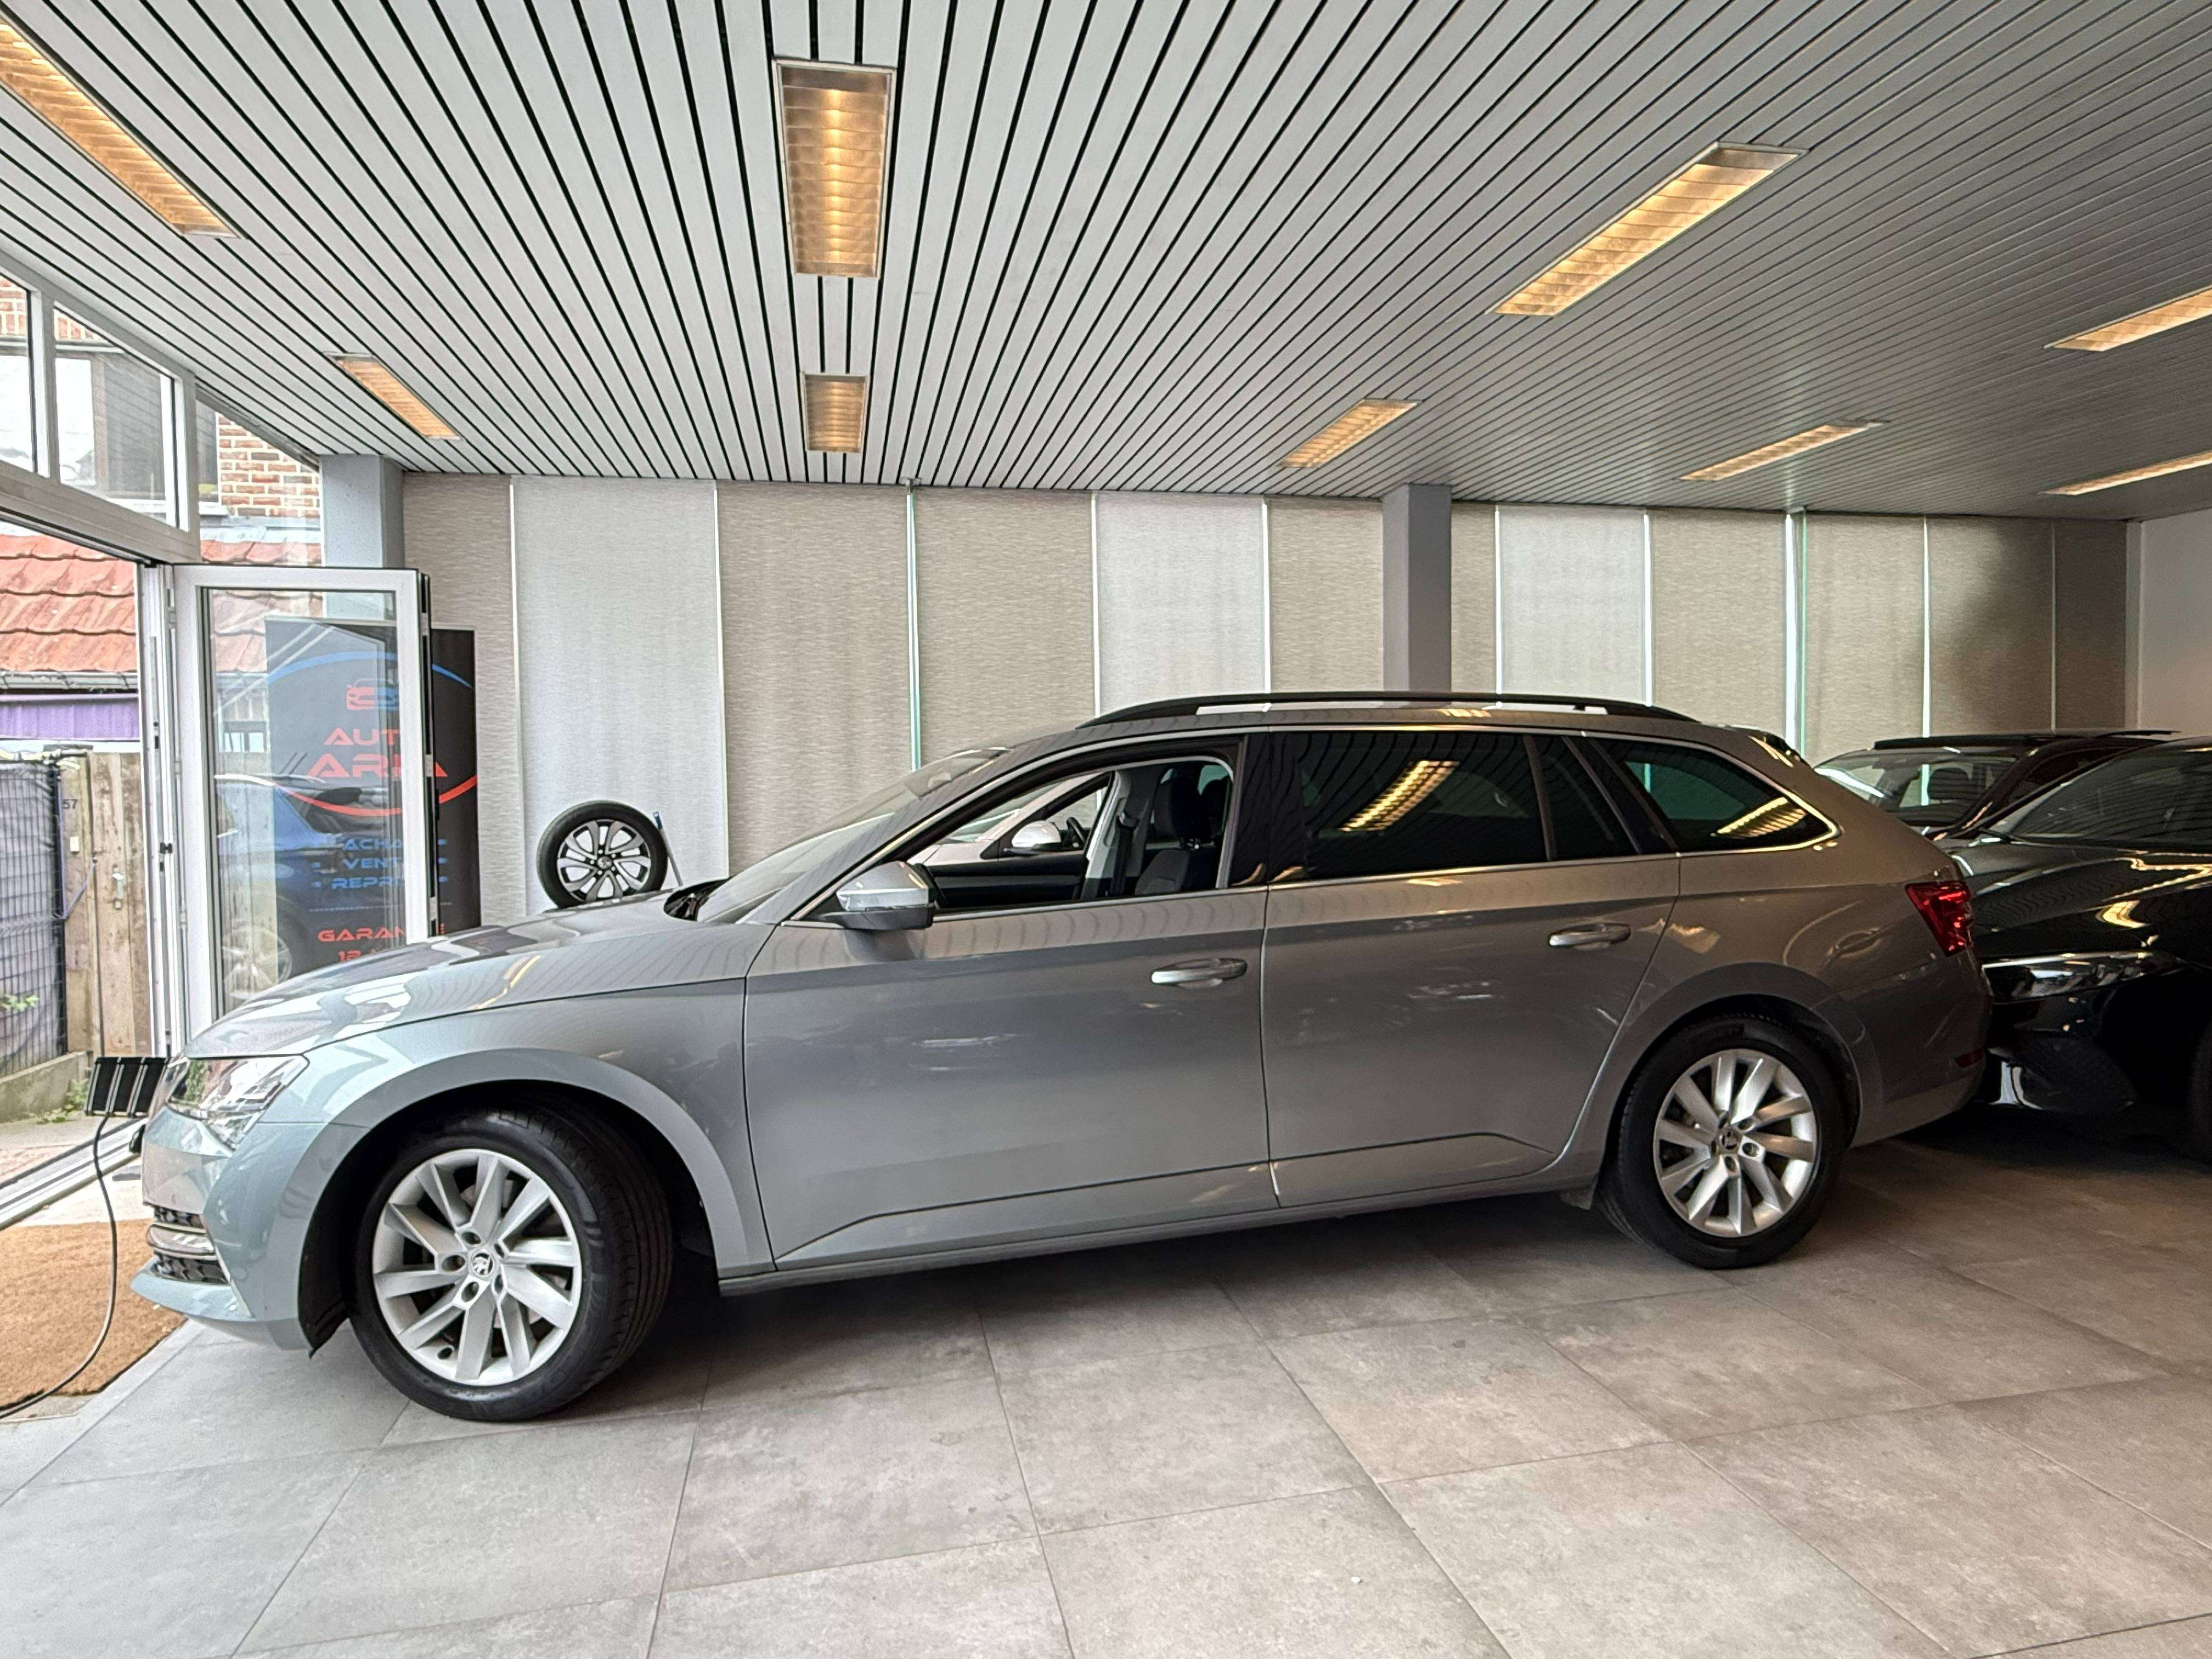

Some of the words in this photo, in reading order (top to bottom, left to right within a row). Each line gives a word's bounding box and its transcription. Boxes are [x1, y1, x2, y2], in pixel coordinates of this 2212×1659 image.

[324, 727, 401, 746] AUT
[62, 799, 78, 809] 57
[343, 838, 403, 850] ACHA
[342, 857, 403, 870] VENT
